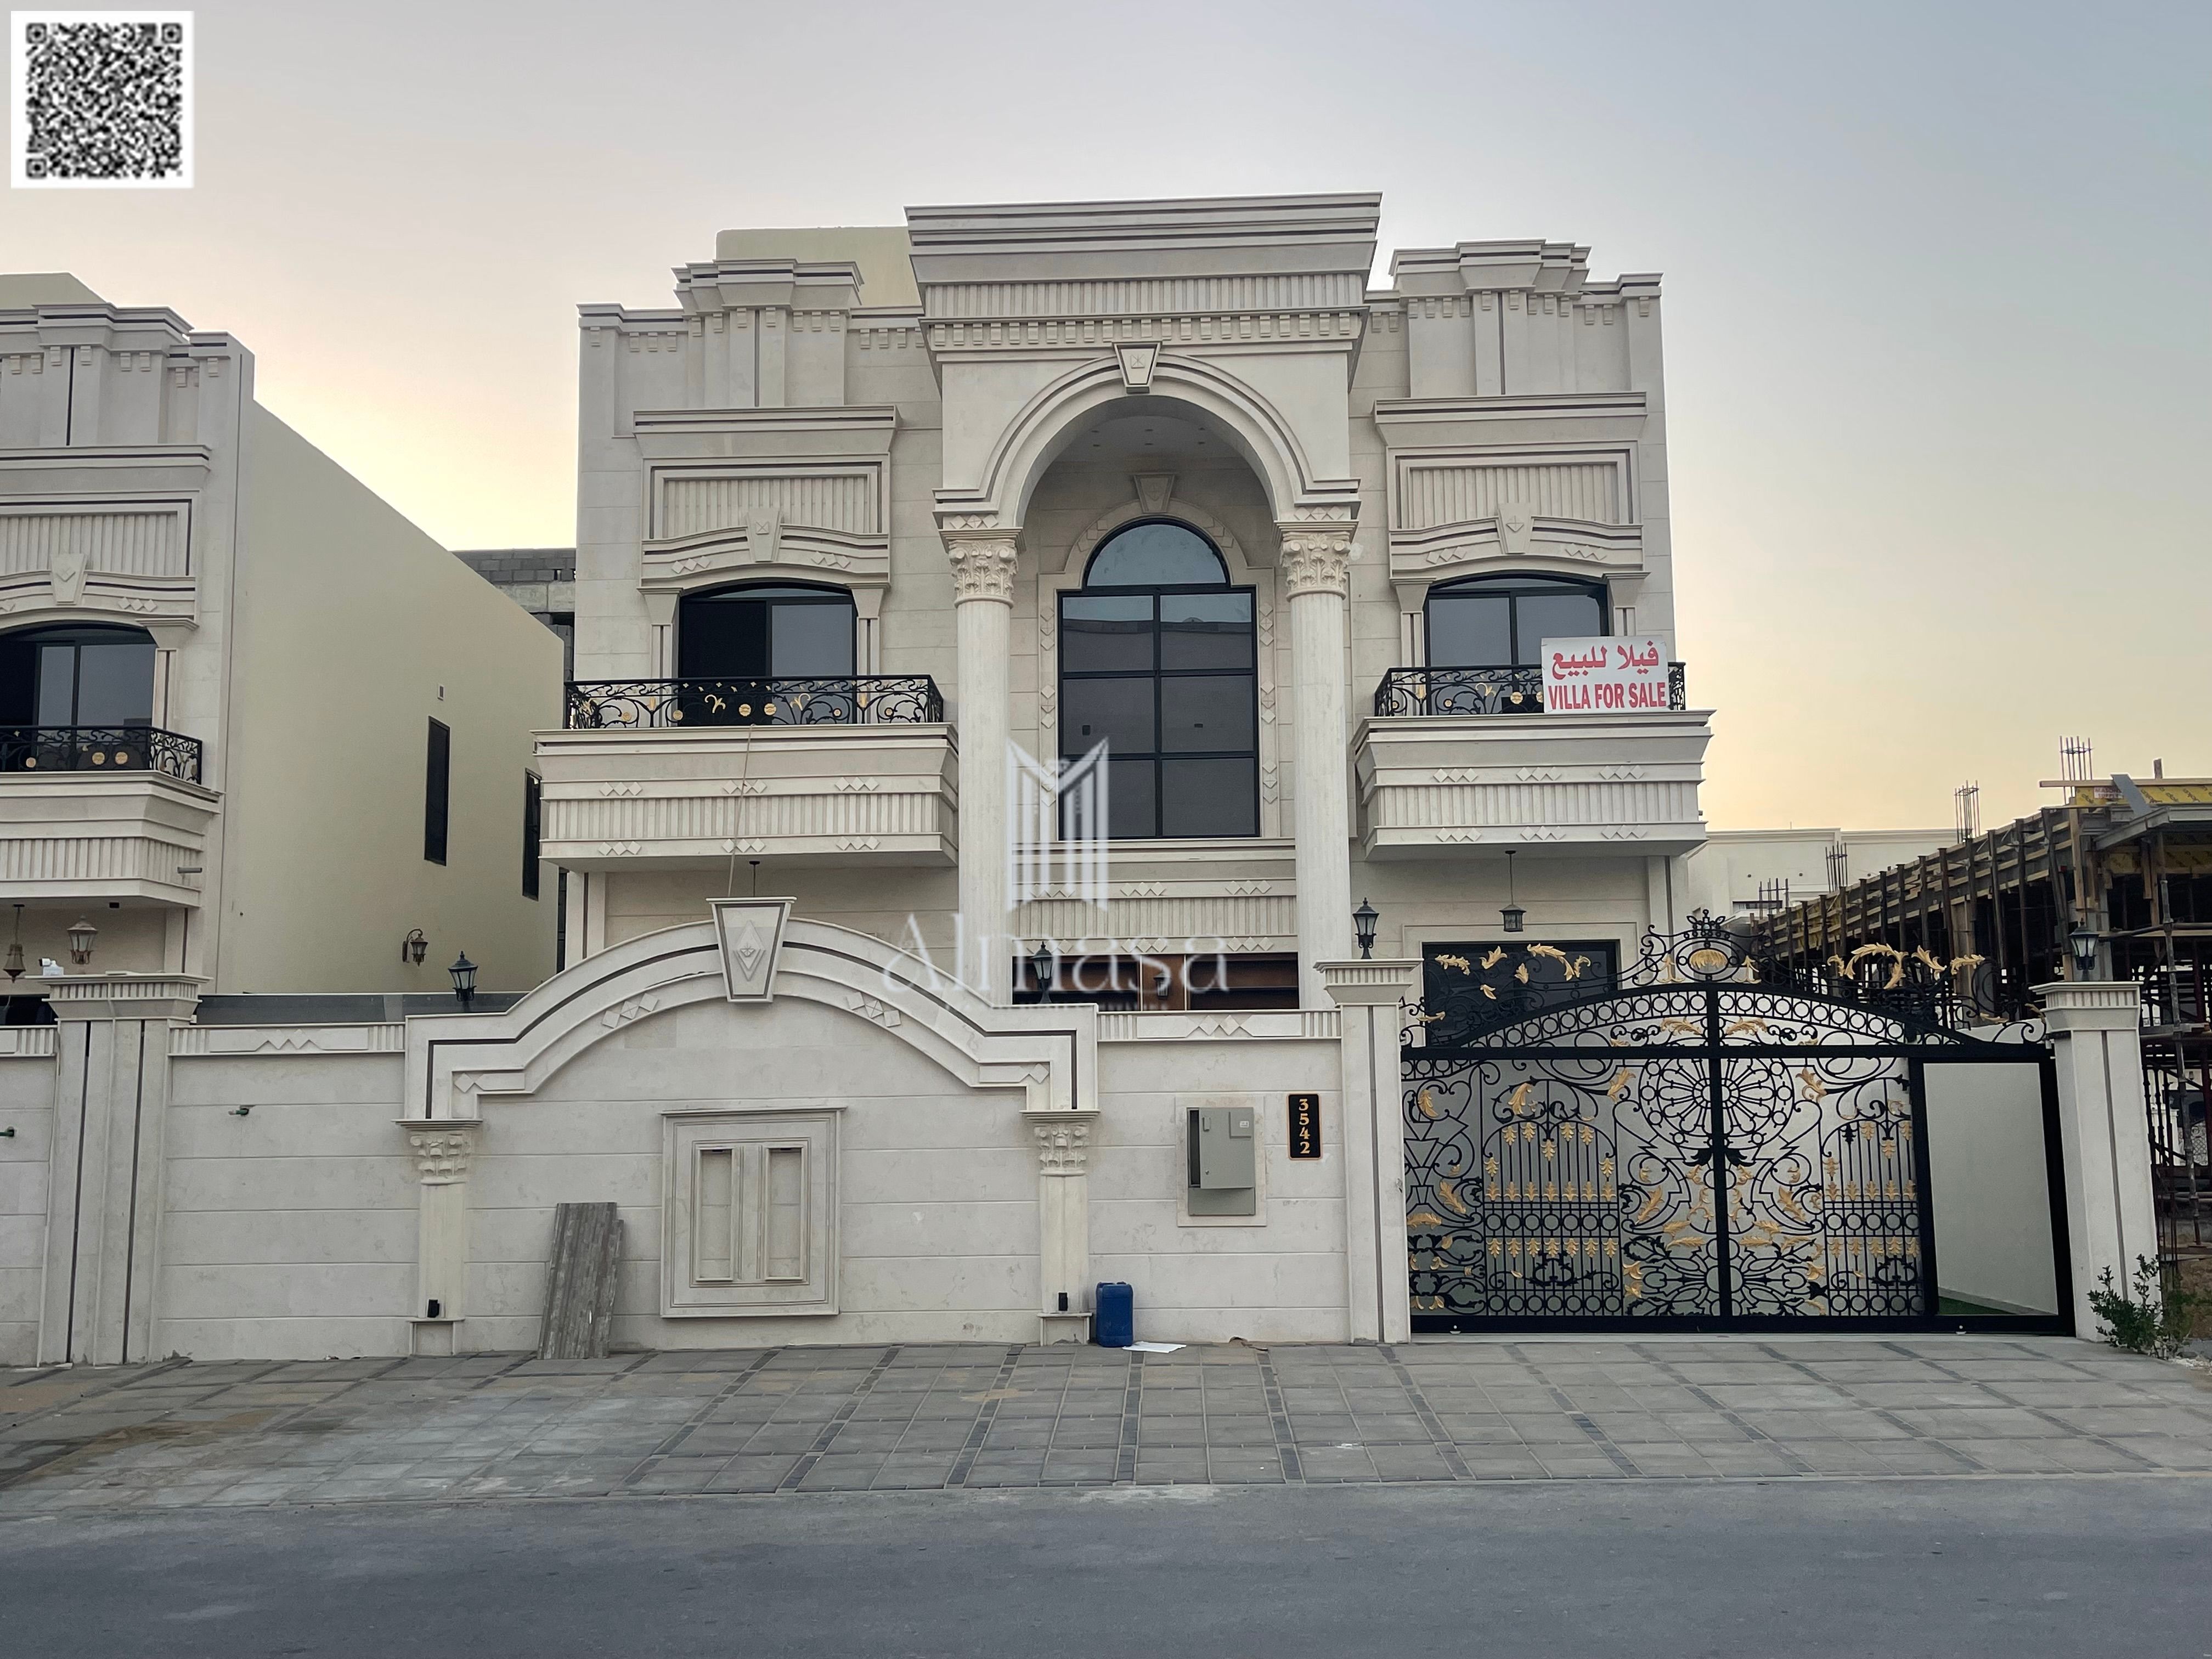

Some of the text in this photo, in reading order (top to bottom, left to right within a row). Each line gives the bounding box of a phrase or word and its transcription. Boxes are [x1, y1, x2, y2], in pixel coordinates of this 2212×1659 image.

[1552, 641, 1660, 680] فيلا للبيع
[1548, 682, 1667, 709] VILLA FOR SALE
[1298, 1098, 1311, 1154] 3542
